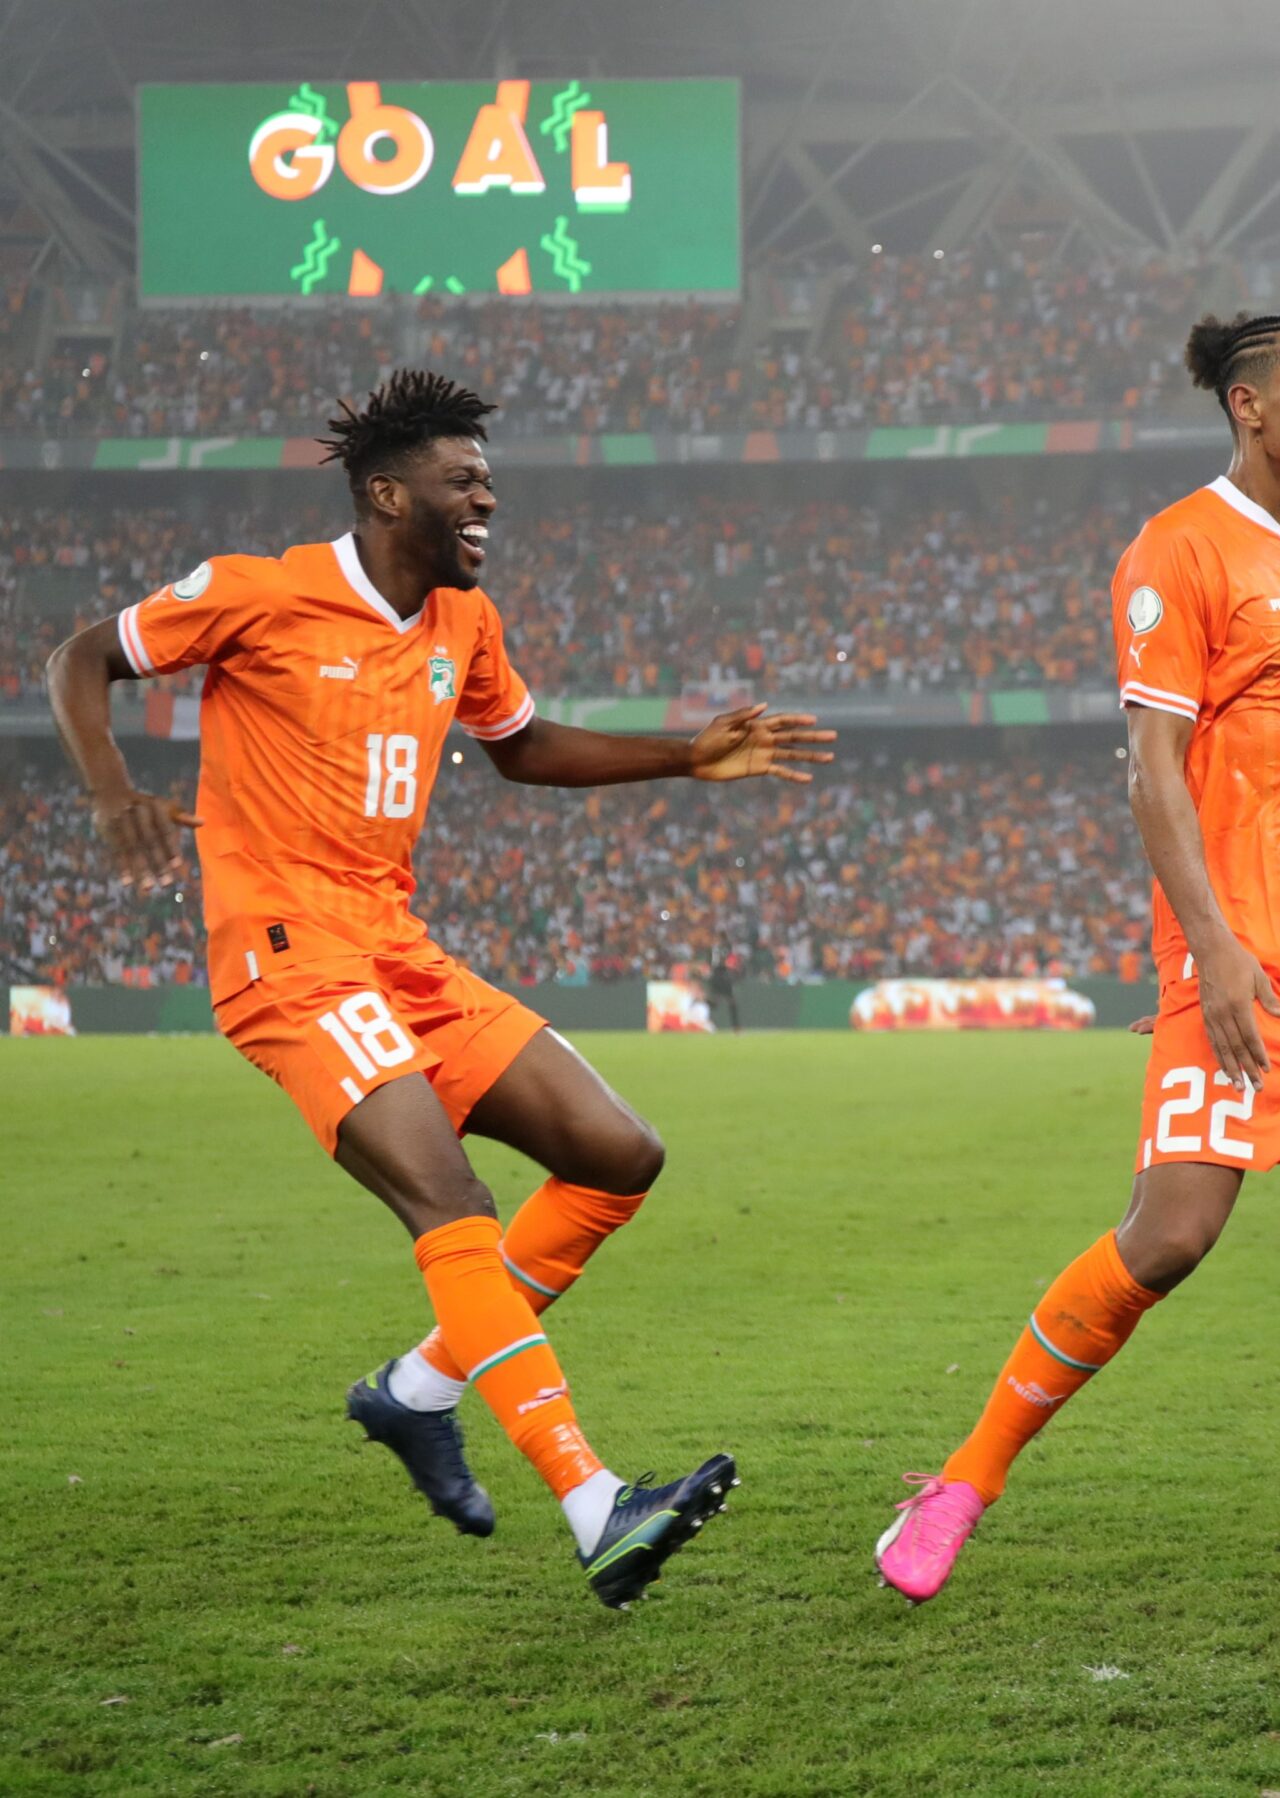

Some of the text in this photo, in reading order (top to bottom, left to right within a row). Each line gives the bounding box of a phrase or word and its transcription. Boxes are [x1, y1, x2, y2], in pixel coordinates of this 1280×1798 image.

[249, 104, 633, 213] GOAL
[364, 732, 419, 818] 18
[317, 990, 416, 1081] 18
[1156, 1066, 1256, 1160] 22
